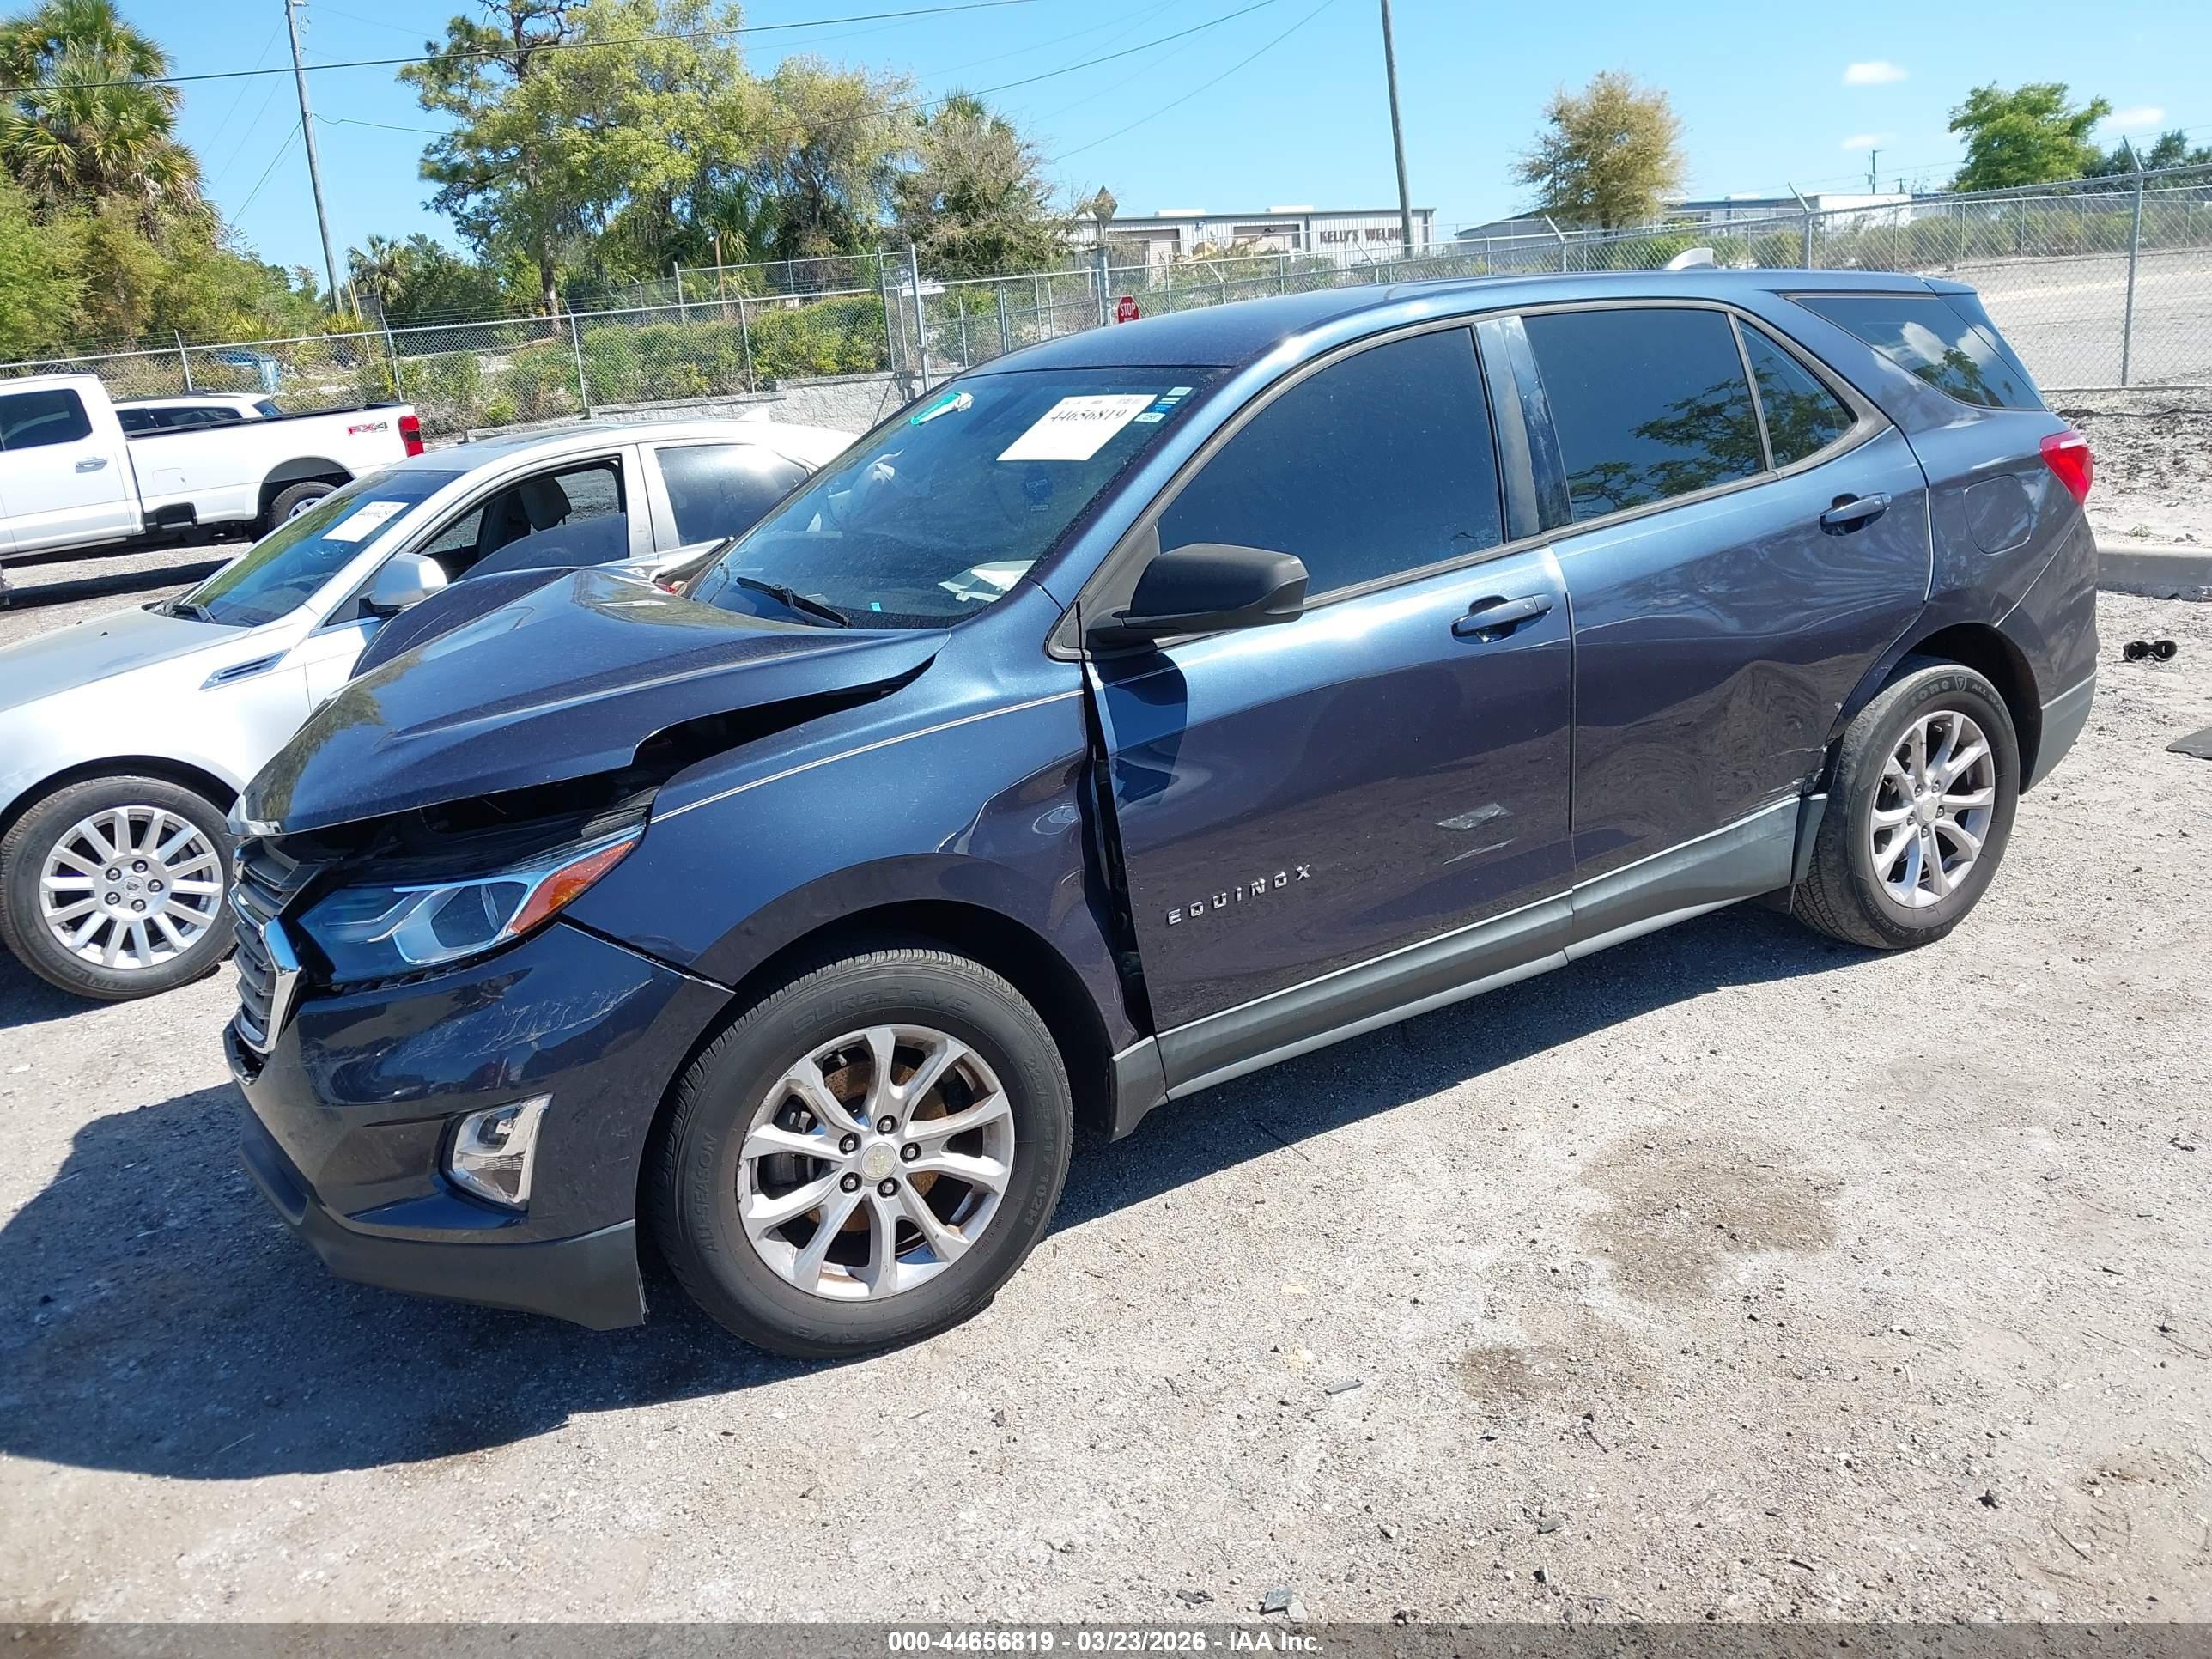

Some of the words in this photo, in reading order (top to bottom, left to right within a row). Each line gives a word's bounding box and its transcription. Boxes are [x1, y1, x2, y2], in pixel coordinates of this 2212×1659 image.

[1120, 301, 1136, 317] STOP
[347, 422, 388, 436] FX4
[1167, 863, 1311, 926] EQUINOX
